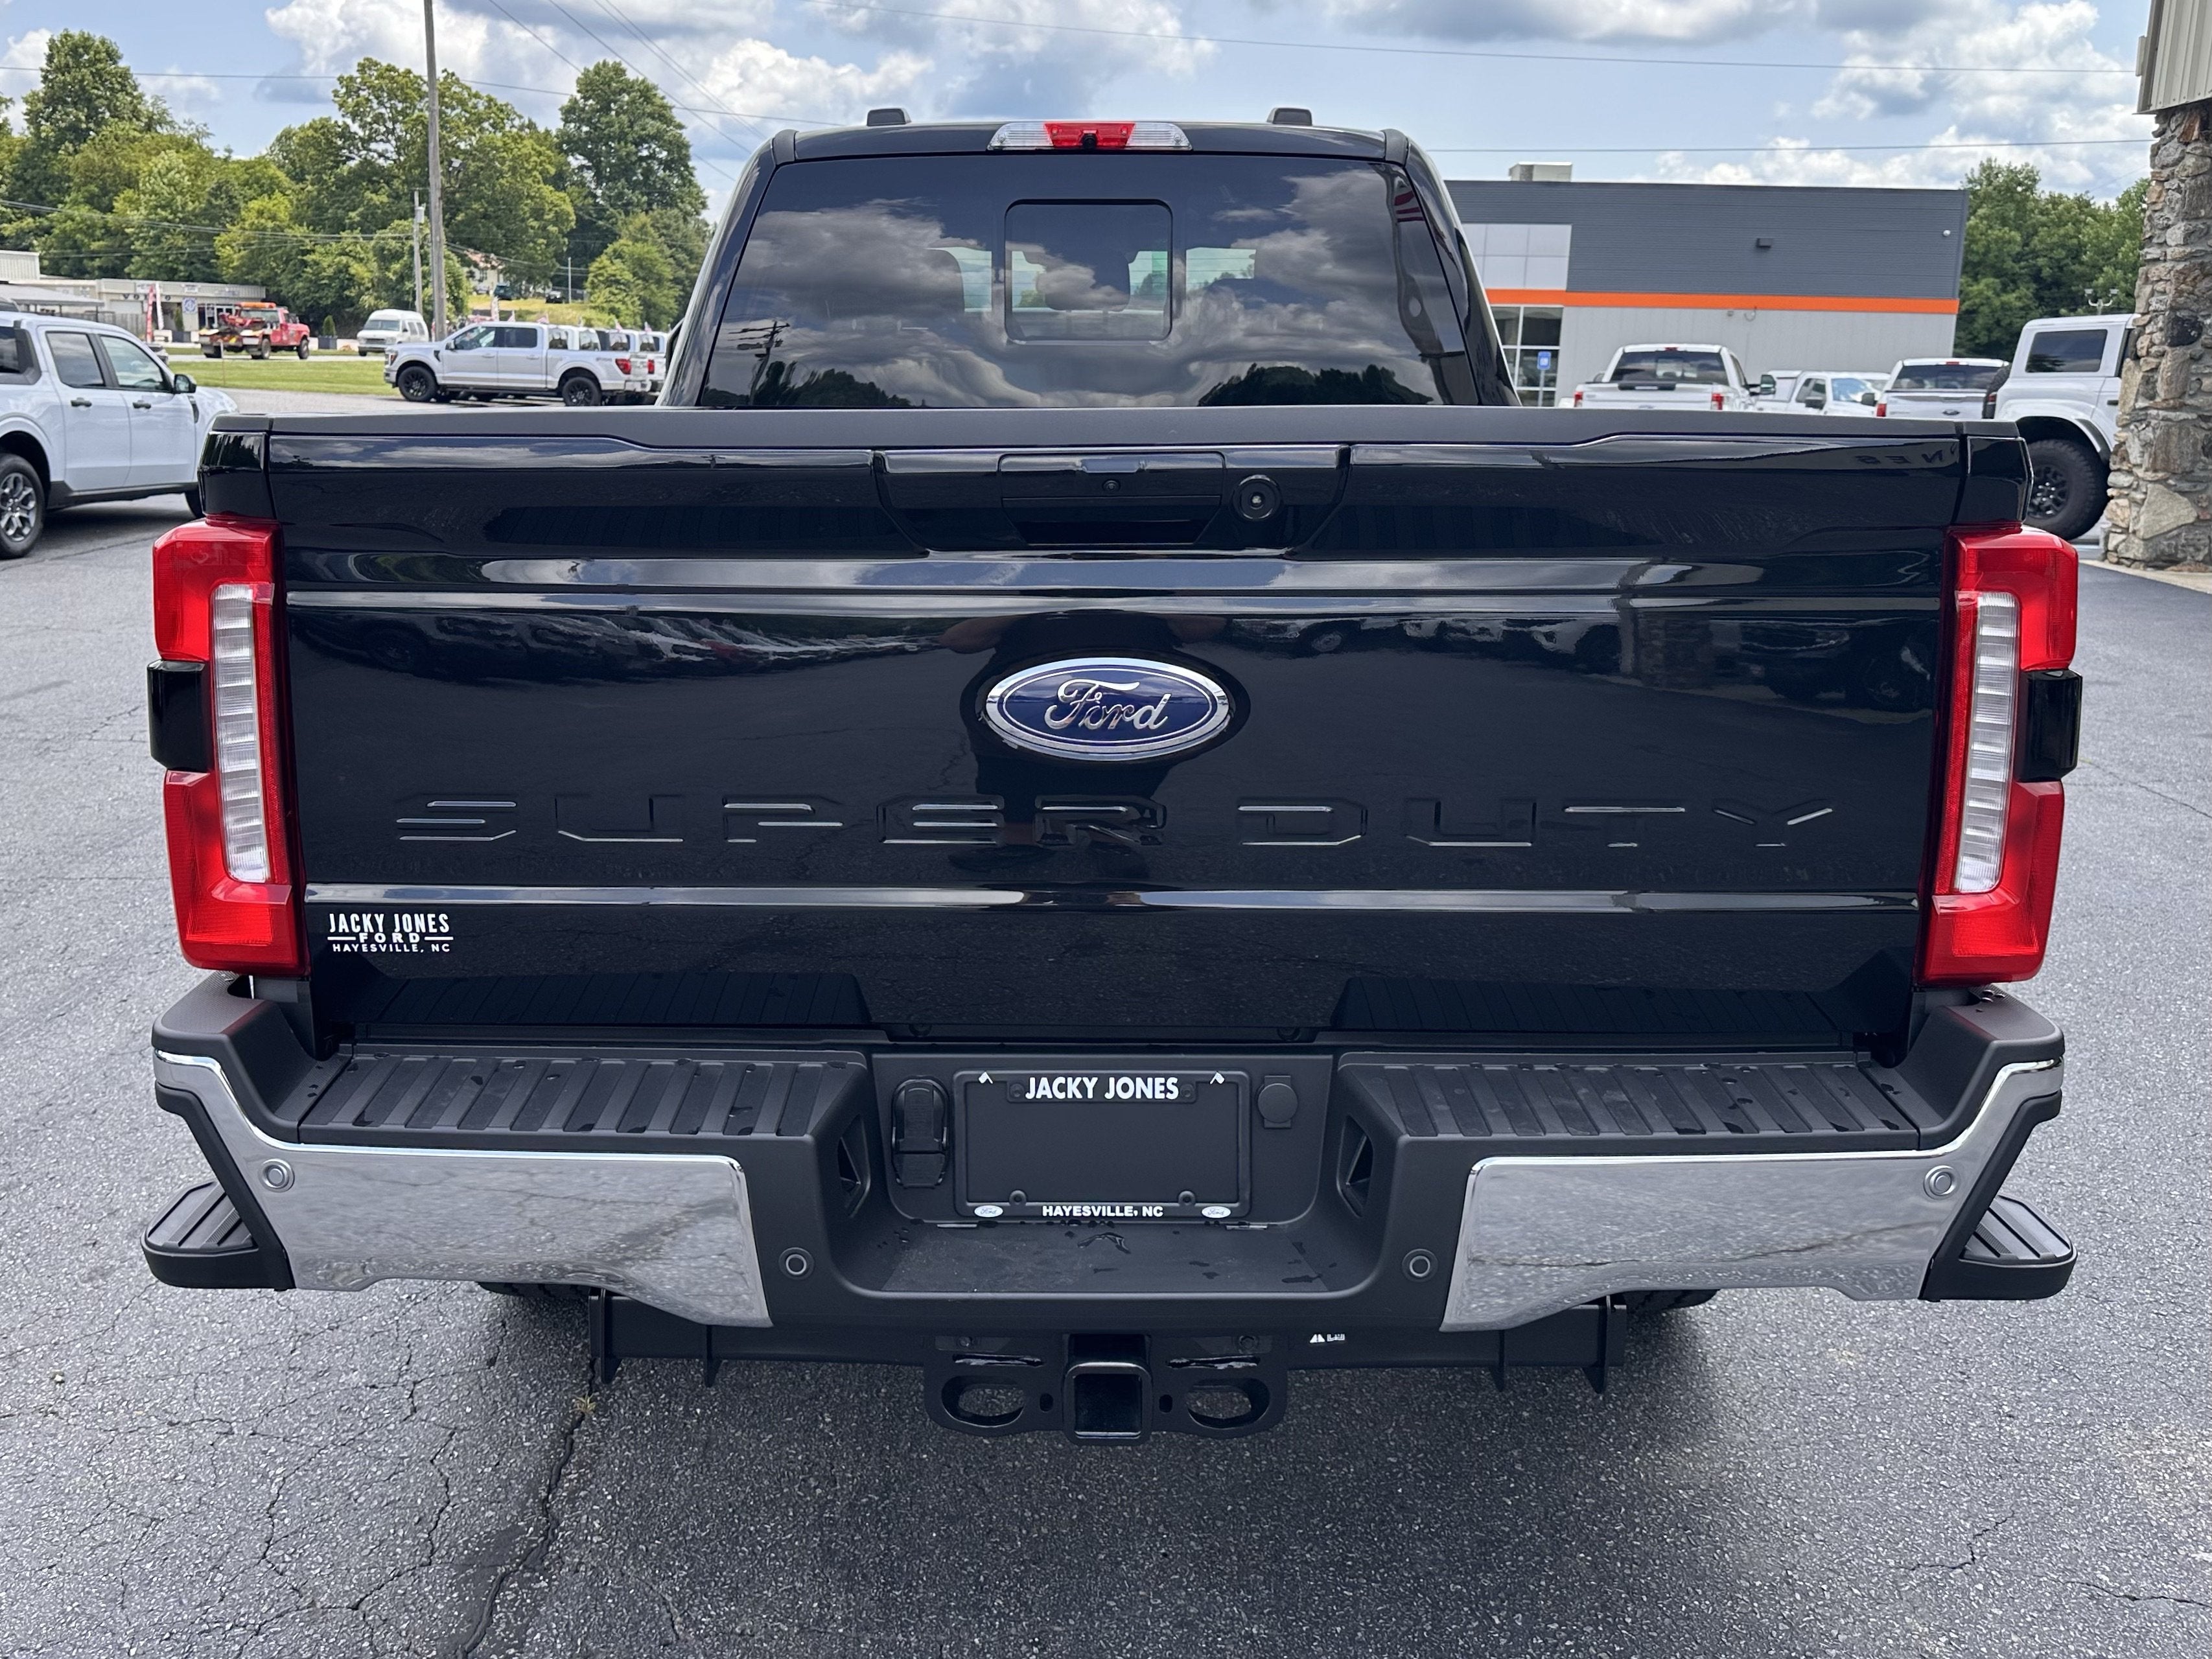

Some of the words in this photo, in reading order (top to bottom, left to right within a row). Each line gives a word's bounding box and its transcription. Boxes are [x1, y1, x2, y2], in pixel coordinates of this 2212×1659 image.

[1044, 678, 1171, 730] Ford
[394, 793, 1167, 846] SUPER
[1235, 797, 1835, 848] DUTY
[329, 913, 385, 933] JACKY
[393, 913, 450, 933] JONES
[358, 932, 421, 944] FORD
[332, 944, 425, 953] HAYESVILLE,
[431, 944, 450, 952] NC
[1025, 1076, 1099, 1100] JACKY
[1104, 1076, 1179, 1100] JONES
[1042, 1205, 1139, 1217] HAYESVILLE,
[1142, 1205, 1164, 1217] NC
